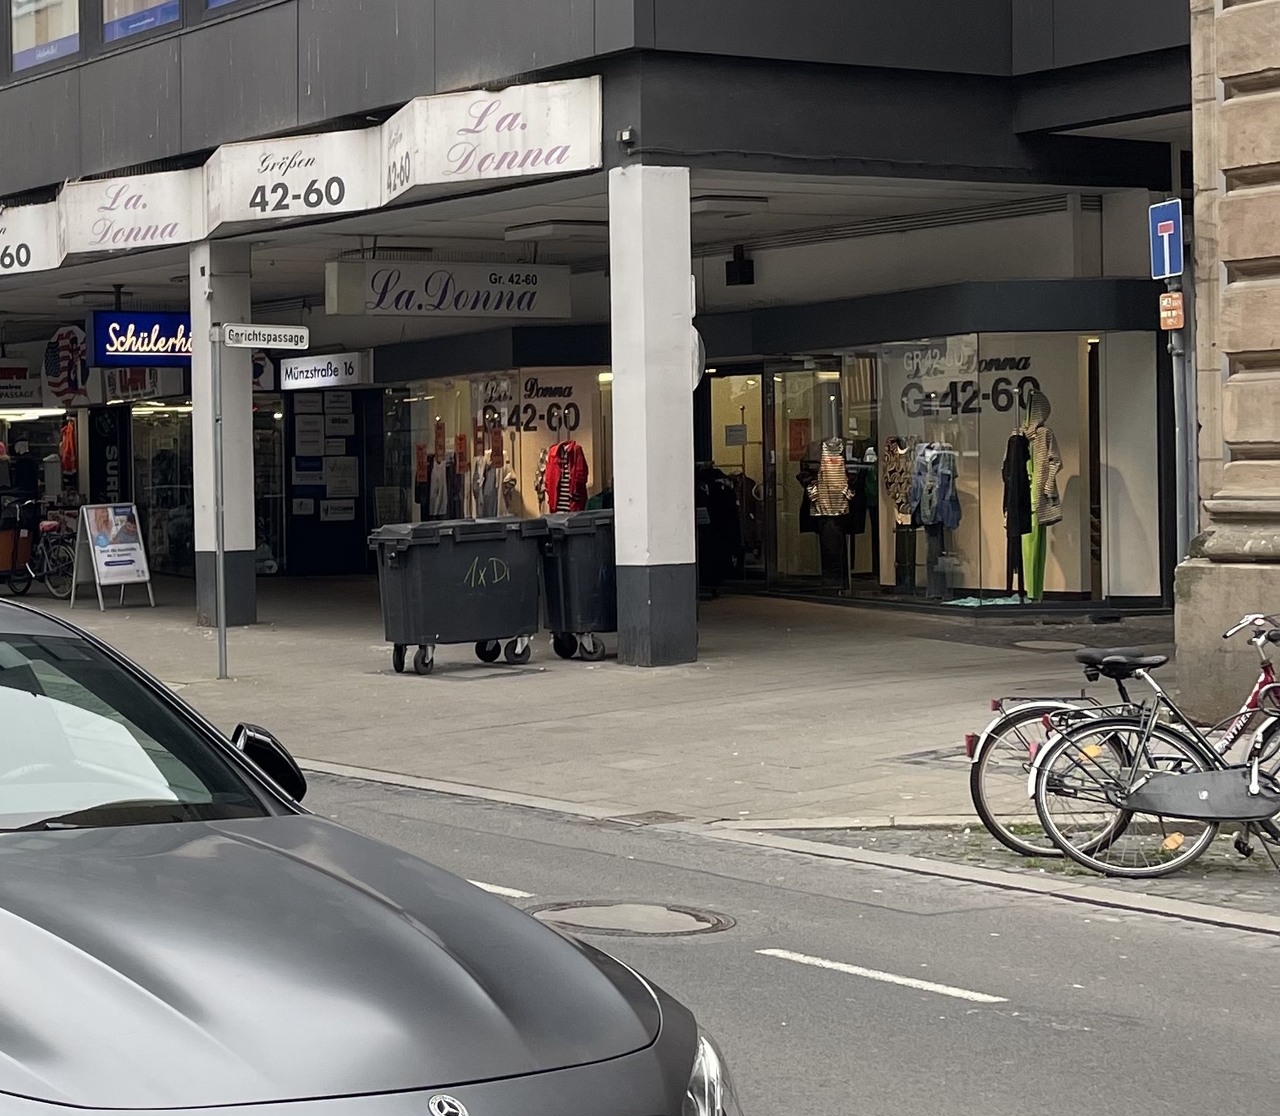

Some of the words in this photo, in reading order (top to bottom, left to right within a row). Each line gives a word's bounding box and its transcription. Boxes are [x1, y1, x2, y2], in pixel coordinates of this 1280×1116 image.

[456, 99, 528, 136] La.
[256, 149, 318, 177] Größen
[386, 150, 411, 194] 42-60
[441, 141, 572, 177] Donna
[97, 183, 148, 212] La.
[248, 175, 346, 213] 42-60
[87, 217, 180, 246] Donna
[488, 272, 505, 285] Gr.
[507, 273, 538, 286] 42-60
[228, 329, 305, 346] Gerichtspassage
[284, 361, 339, 382] Münzstraße
[343, 361, 355, 376] 16
[523, 377, 573, 400] Donna
[507, 402, 581, 433] 42-60
